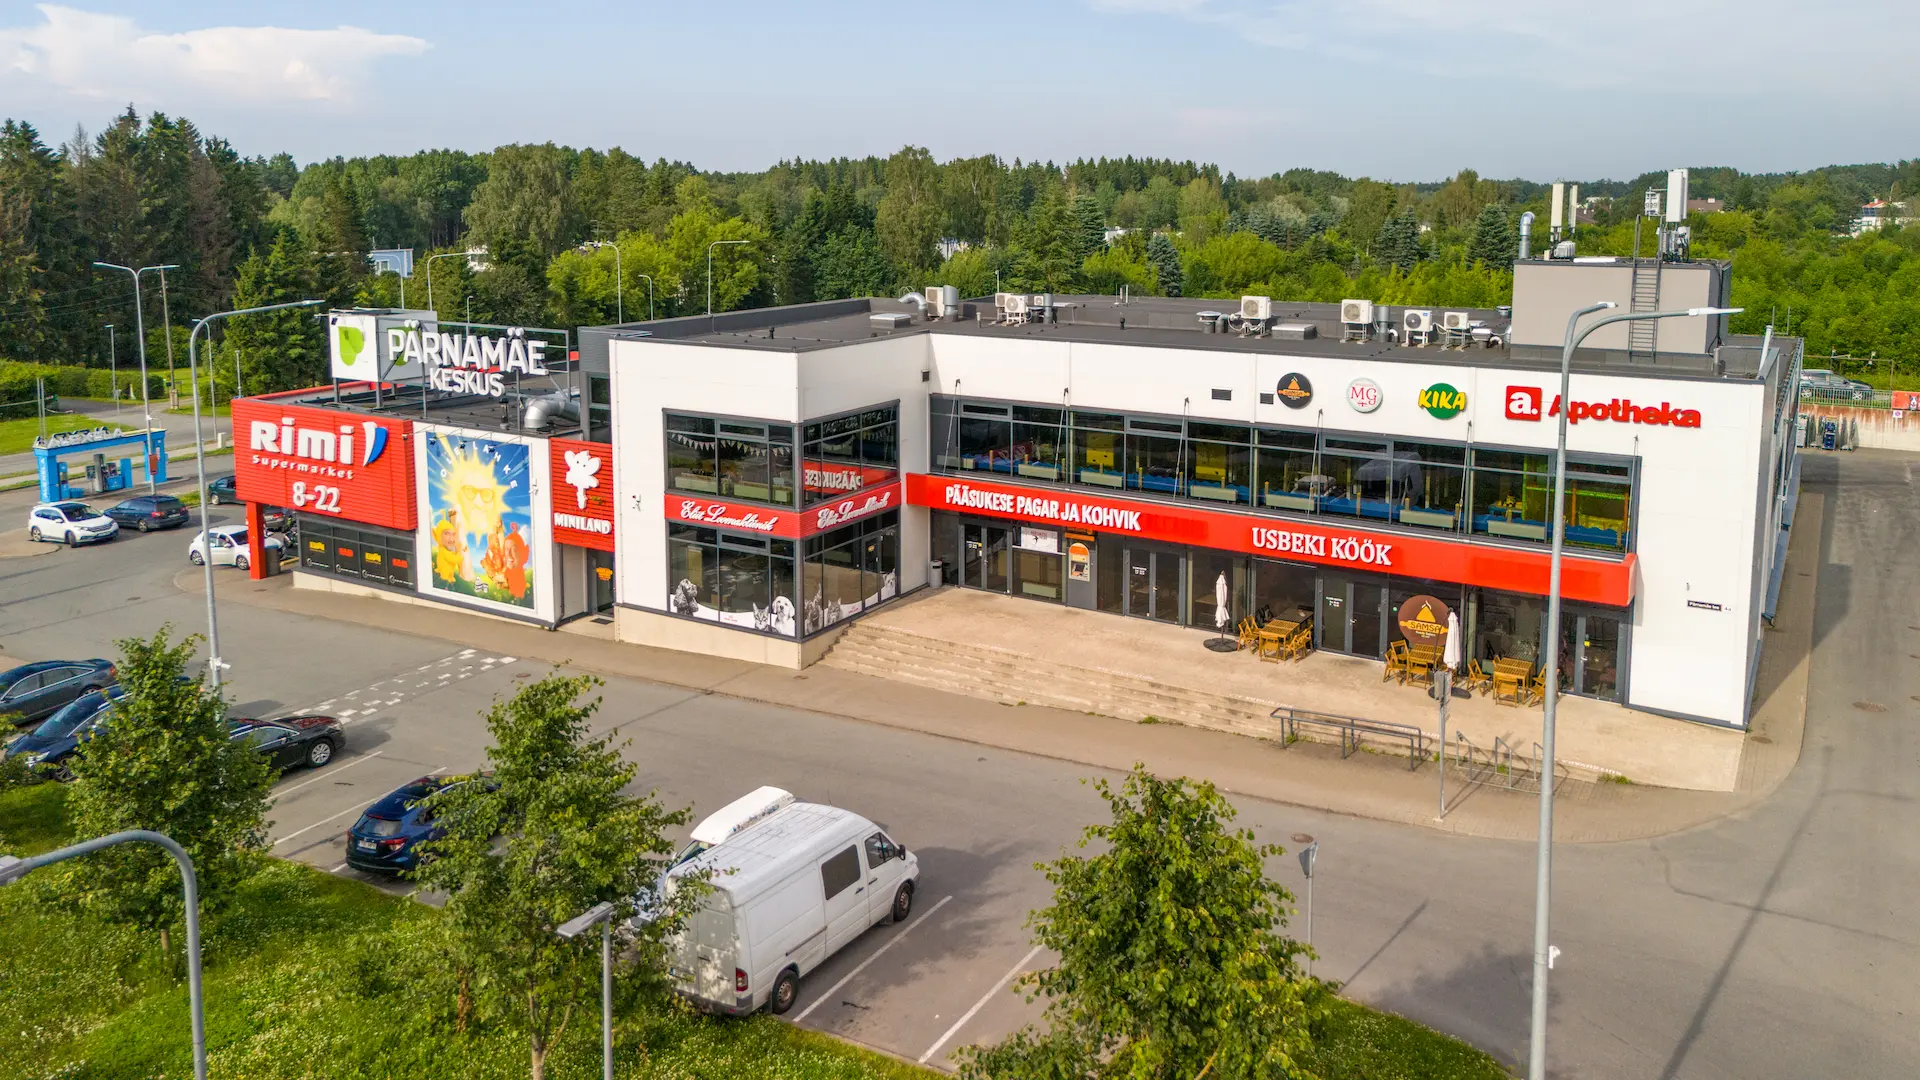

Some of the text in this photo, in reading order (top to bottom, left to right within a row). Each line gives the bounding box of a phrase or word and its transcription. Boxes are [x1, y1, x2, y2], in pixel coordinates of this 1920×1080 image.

[387, 319, 549, 376] PÄRNAMÄE
[429, 367, 506, 397] KESKUS
[1350, 386, 1377, 406] MG
[1418, 389, 1467, 411] KIKA
[1548, 394, 1701, 429] Apotheka
[251, 417, 355, 465] Rimi
[252, 455, 355, 480] Supermarket
[292, 481, 342, 513] 8-22
[945, 483, 1142, 531] PÄÄSUKESE PAGAR JA KOHVIK
[554, 512, 612, 534] MINILAND
[1251, 527, 1393, 566] USBEKI KÖÖK
[1410, 621, 1441, 633] SAMSA
